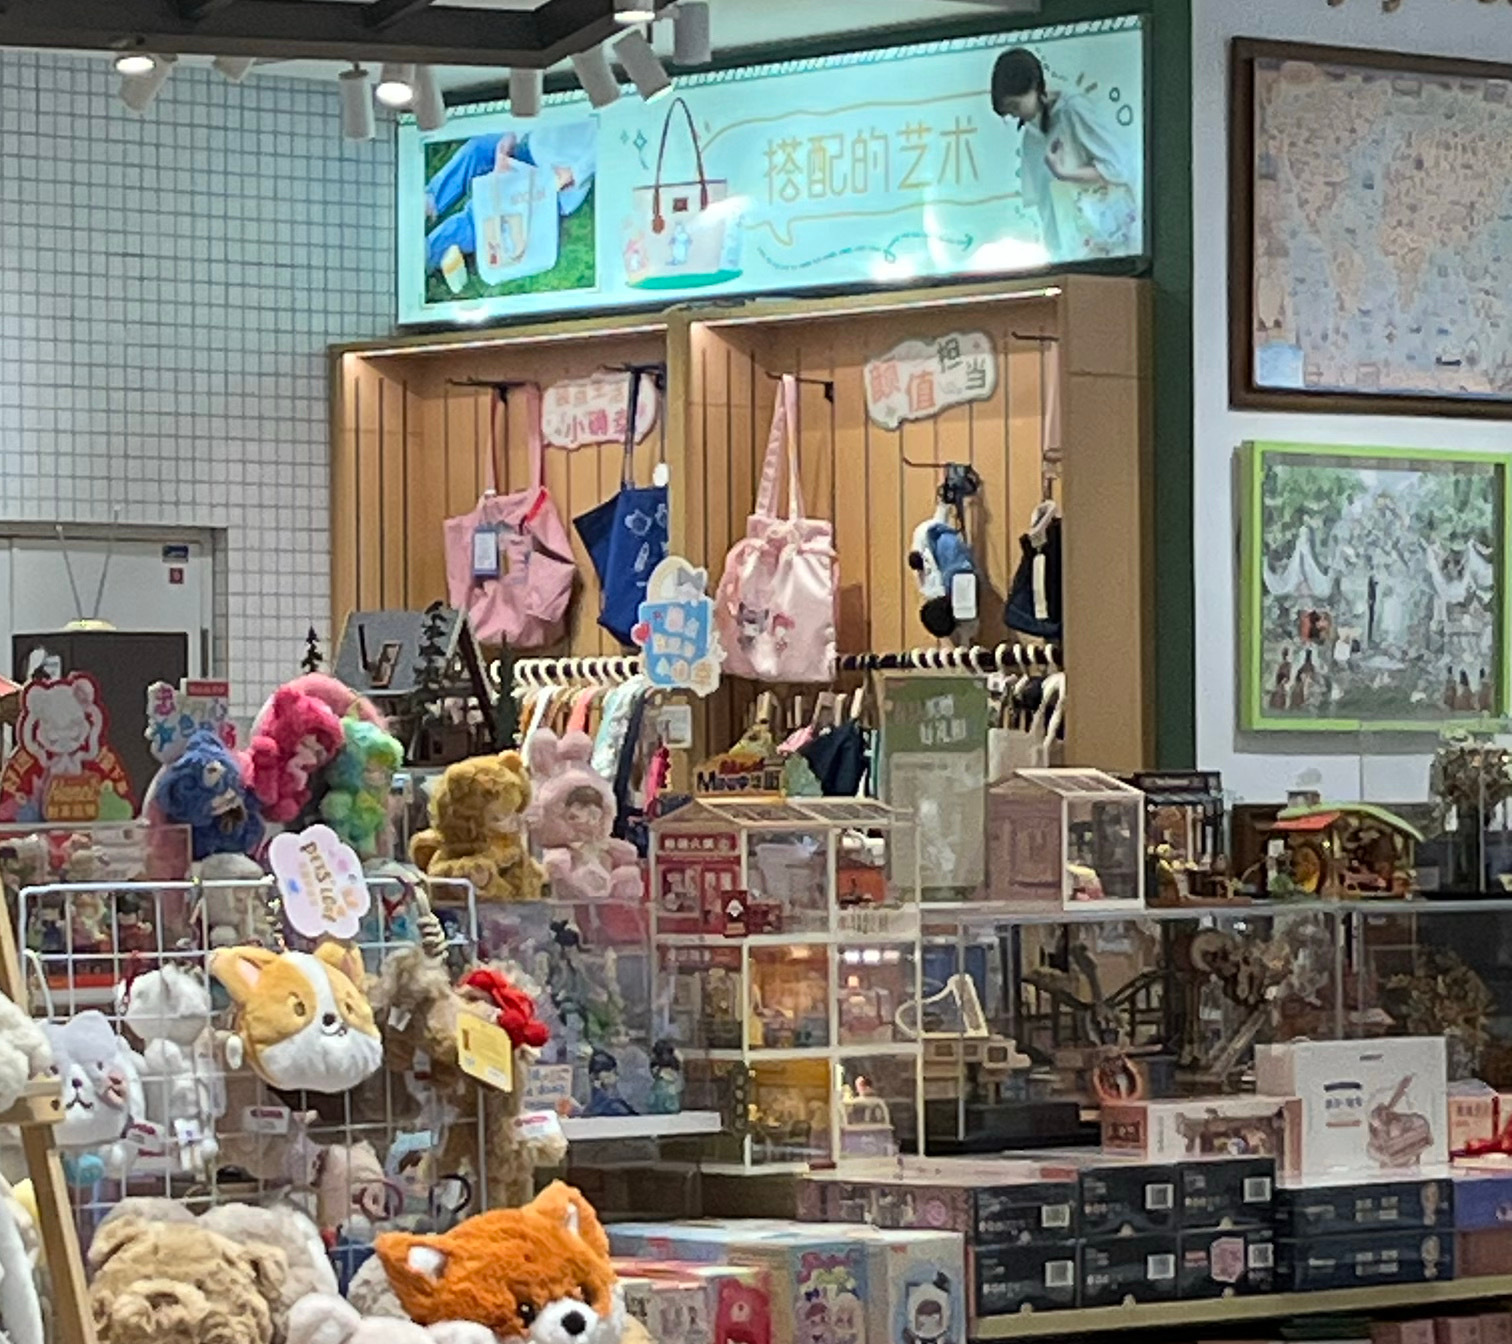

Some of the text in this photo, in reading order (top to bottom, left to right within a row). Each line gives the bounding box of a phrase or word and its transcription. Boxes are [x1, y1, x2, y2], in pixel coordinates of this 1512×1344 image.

[763, 115, 979, 206] 搭配的艺术
